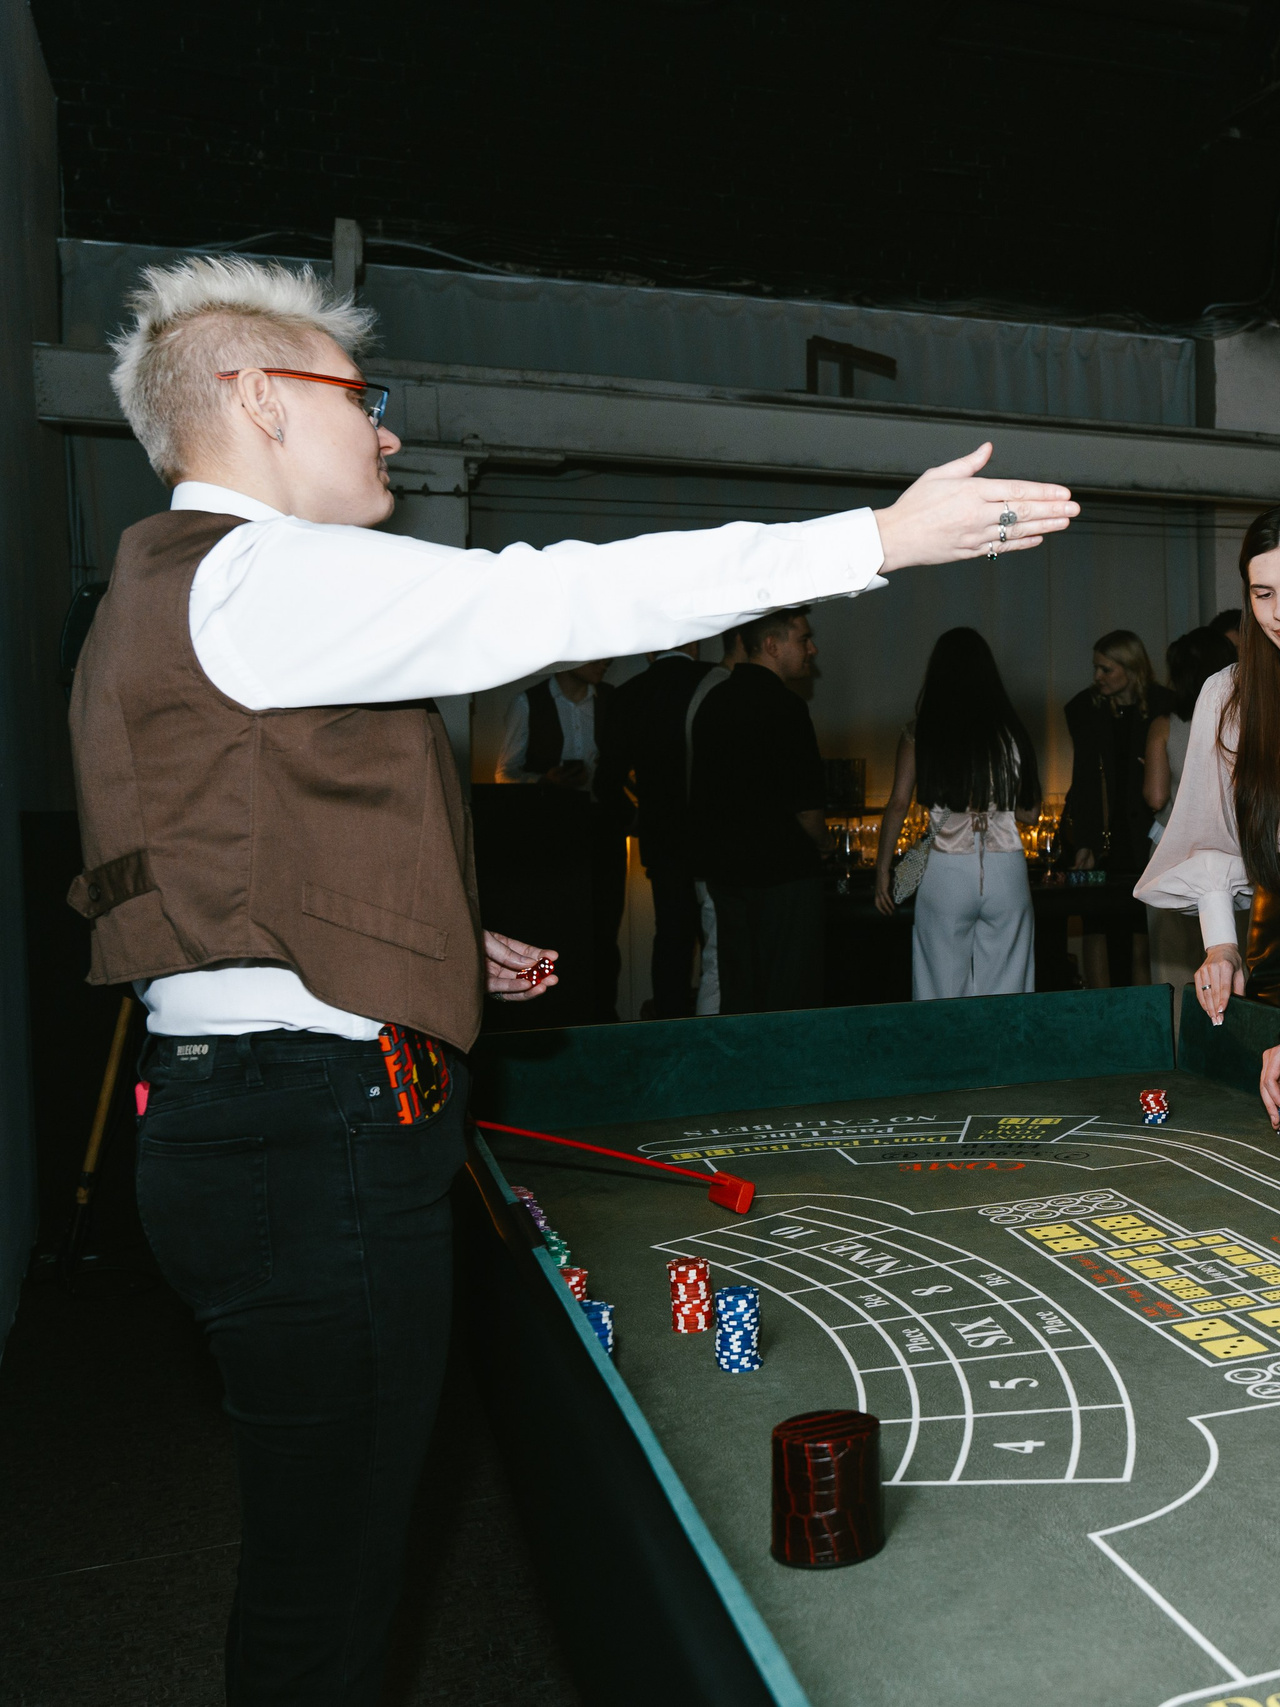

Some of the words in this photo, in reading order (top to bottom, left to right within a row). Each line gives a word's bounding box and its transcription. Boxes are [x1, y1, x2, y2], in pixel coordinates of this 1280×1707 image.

[784, 1117, 880, 1129] CALL
[891, 1114, 938, 1123] NO
[683, 1123, 773, 1138] BETS
[753, 1130, 820, 1140] Line
[832, 1126, 895, 1135] Pass
[801, 1140, 861, 1148] Pass
[873, 1135, 947, 1145] Don't
[739, 1144, 790, 1153] Bar
[900, 1161, 1026, 1171] COME
[770, 1226, 820, 1239] 10
[821, 1240, 914, 1274] NINE
[977, 1273, 1011, 1287] Bet
[911, 1285, 953, 1296] 8
[856, 1293, 890, 1308] Bet
[1036, 1310, 1072, 1334] Place
[950, 1316, 1015, 1348] SIX
[902, 1327, 935, 1353] Place
[1233, 1371, 1262, 1381] C
[989, 1377, 1039, 1390] 5
[993, 1440, 1046, 1454] 4
